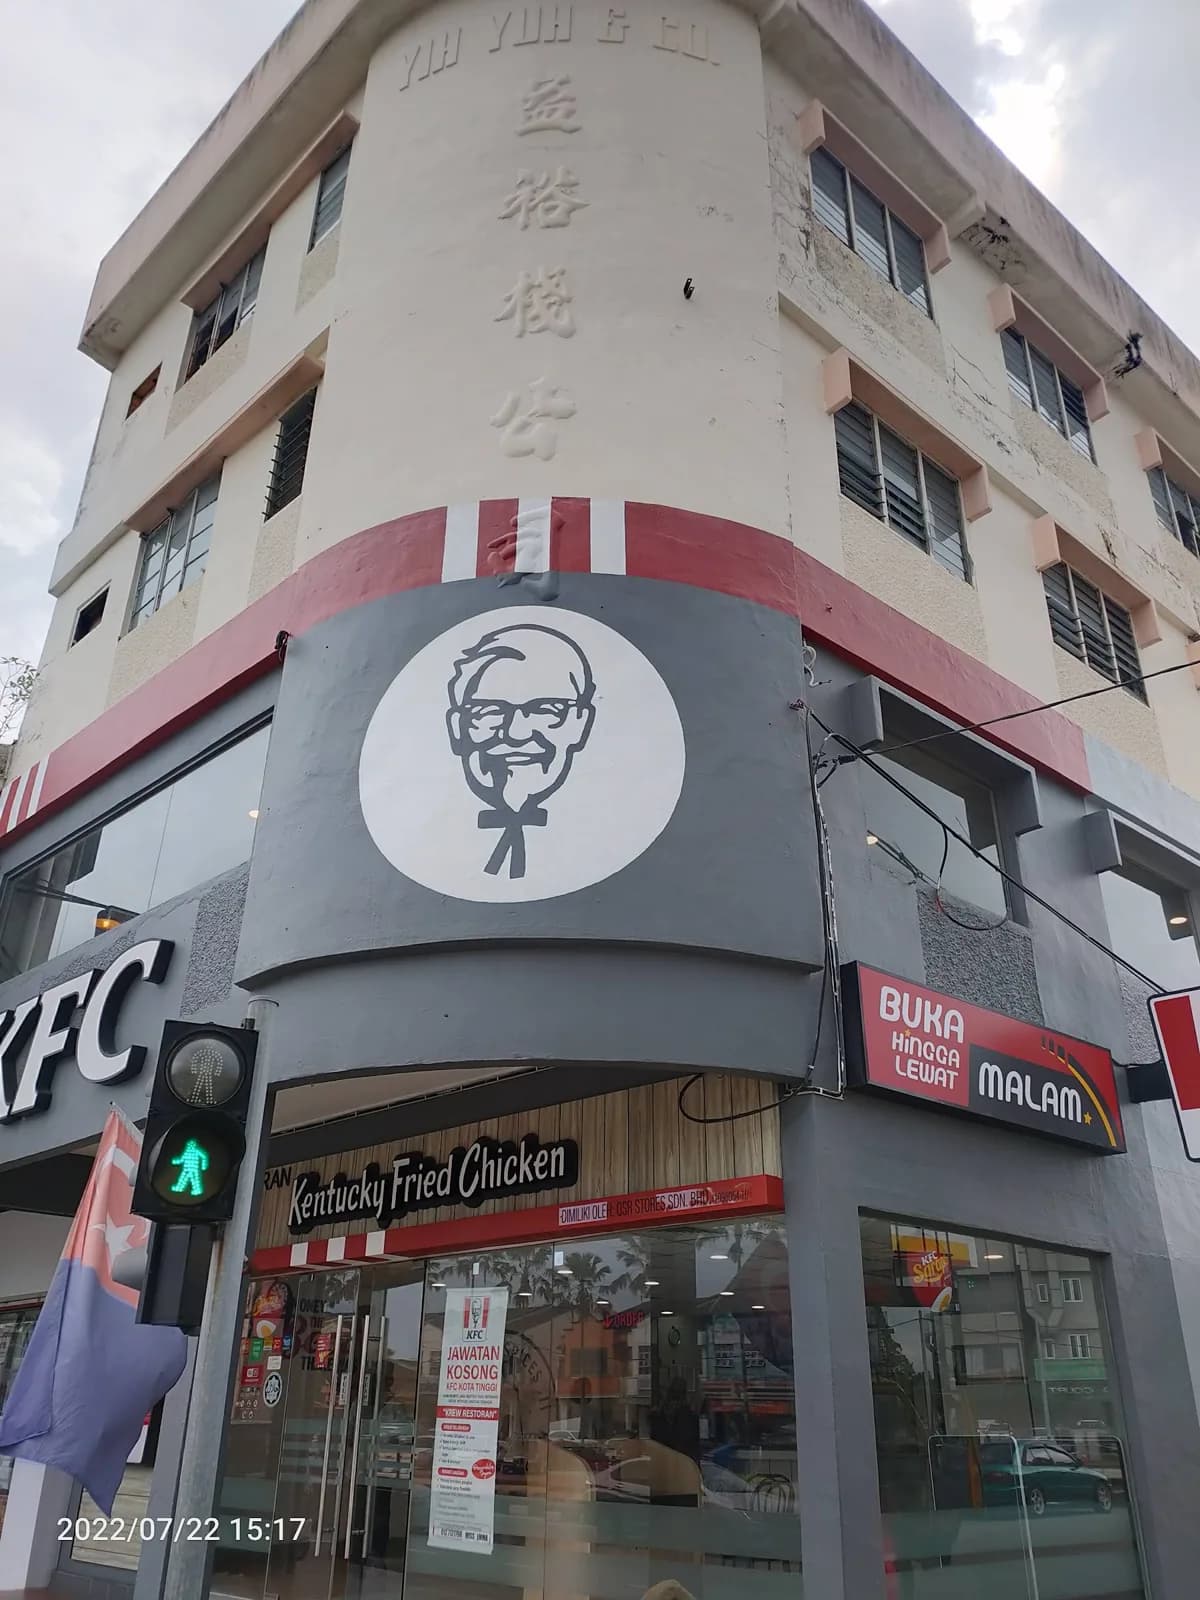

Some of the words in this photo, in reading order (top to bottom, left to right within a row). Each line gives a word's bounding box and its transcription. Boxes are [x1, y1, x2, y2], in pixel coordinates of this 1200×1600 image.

[488, 5, 574, 54] YUH
[878, 984, 965, 1044] BUKA
[894, 1056, 960, 1091] LEWAT
[977, 1061, 1083, 1124] MALAM
[287, 1168, 385, 1227] Kentucky
[391, 1153, 454, 1211] Fried
[458, 1140, 566, 1199] Chicken
[560, 1206, 591, 1224] DIMILIKI
[634, 1195, 666, 1215] STORES
[920, 1250, 938, 1266] KFC
[466, 1329, 484, 1340] KFC
[447, 1344, 500, 1361] JAWATAN
[446, 1364, 499, 1380] KOSONG
[459, 1382, 475, 1392] KOTA
[475, 1382, 498, 1393] TINGGI
